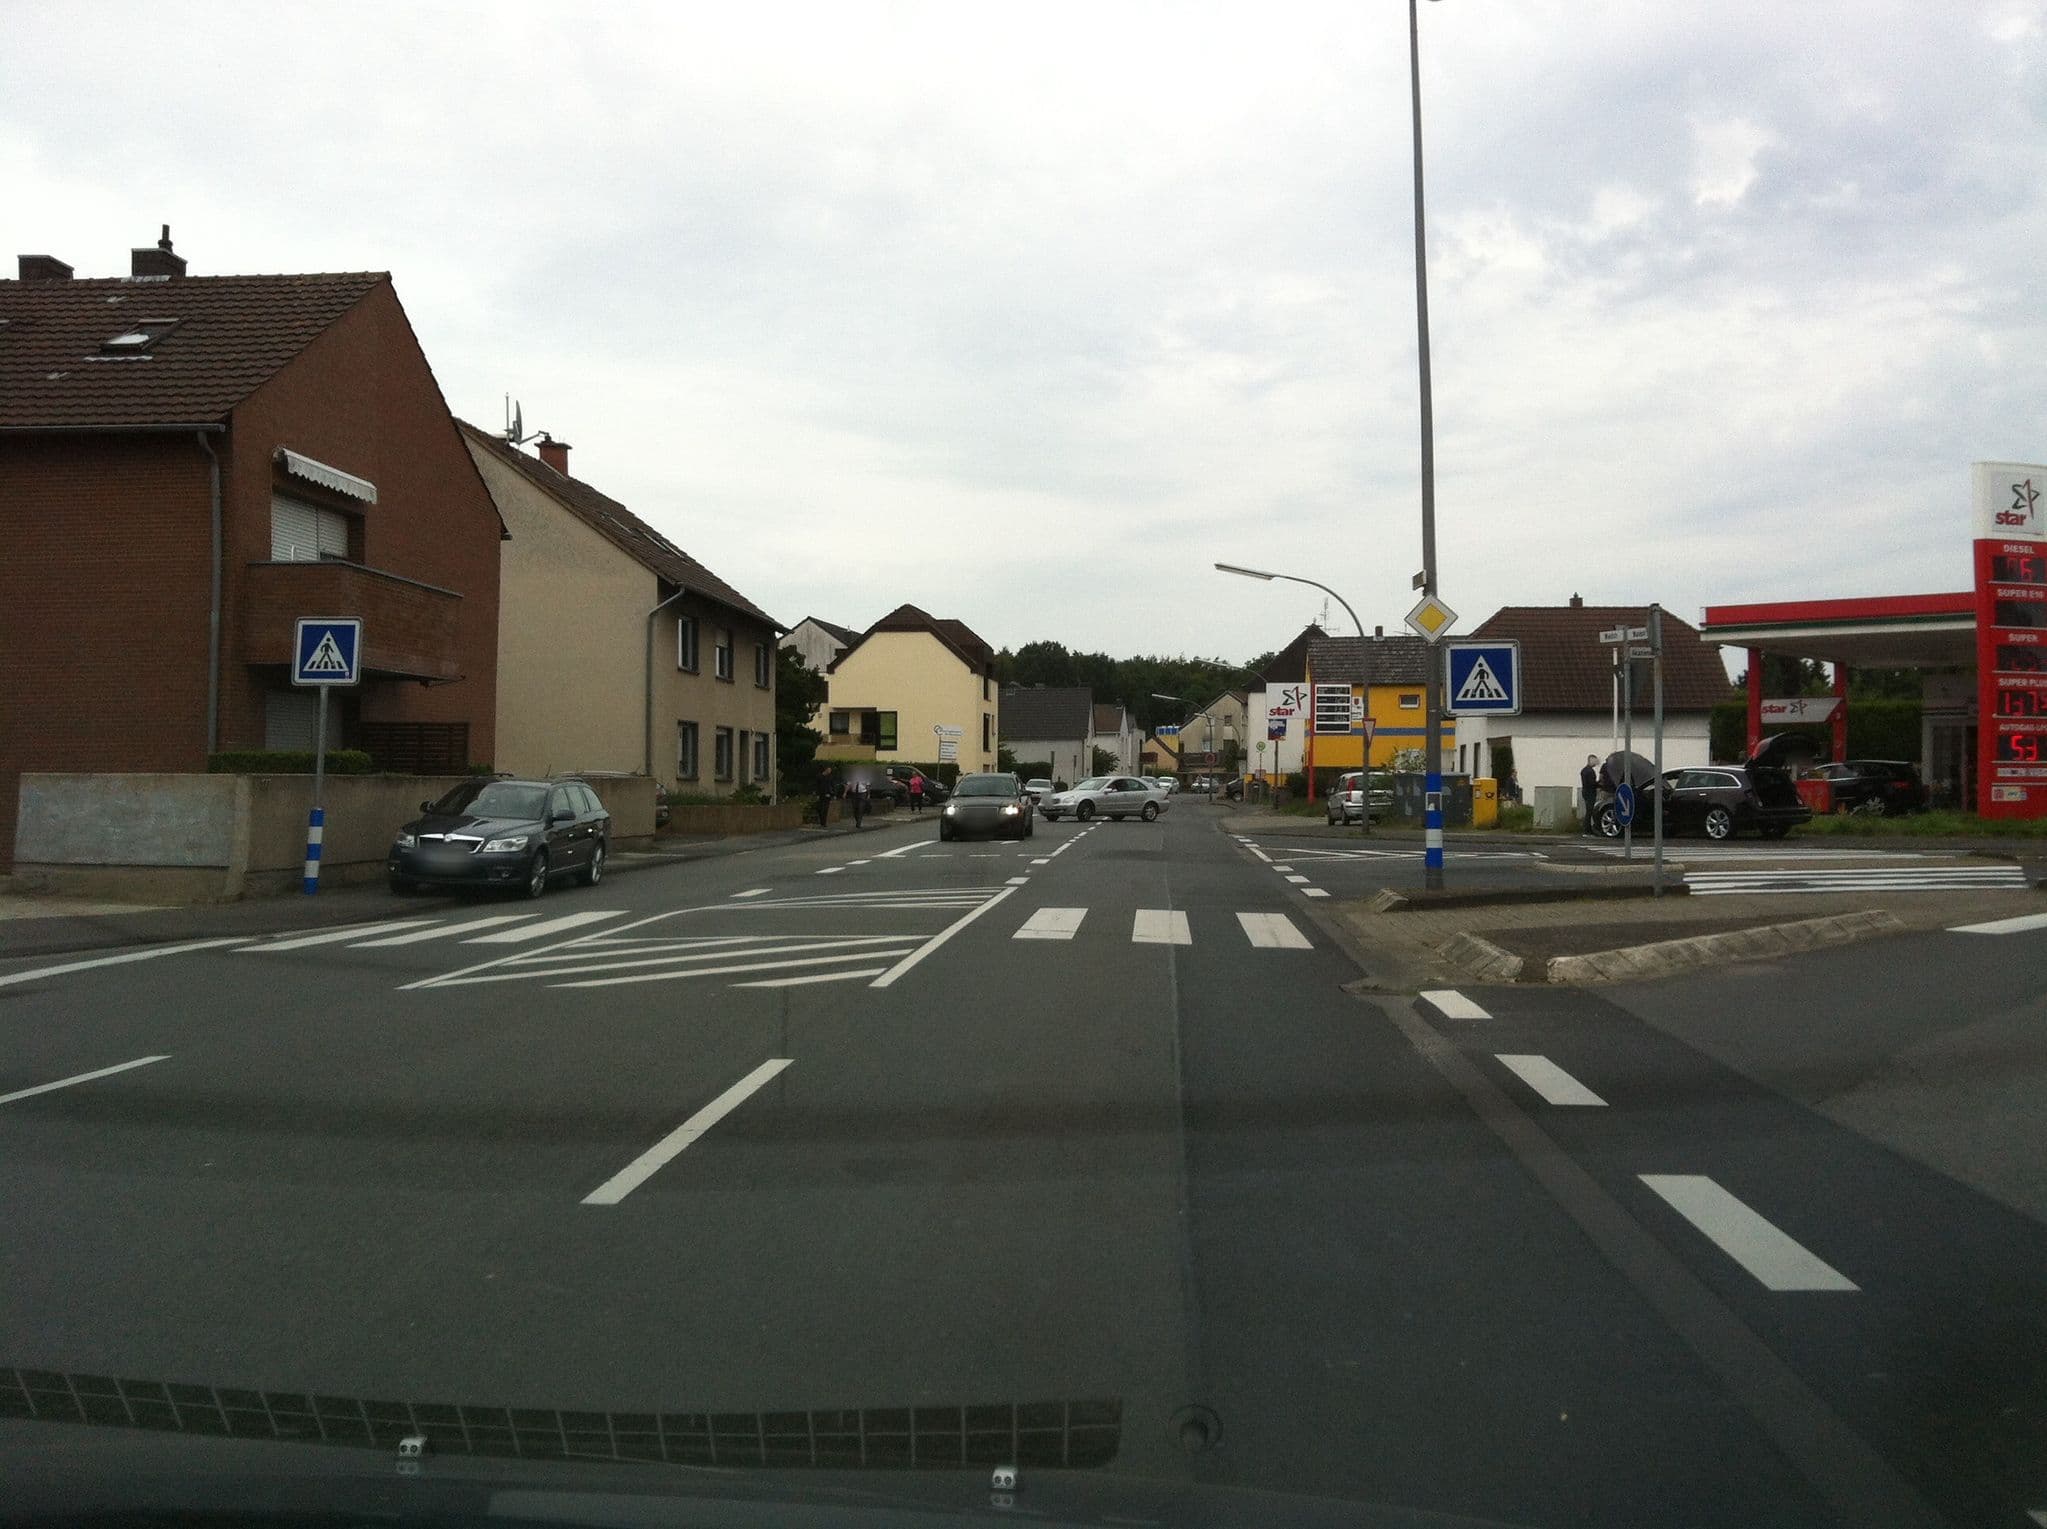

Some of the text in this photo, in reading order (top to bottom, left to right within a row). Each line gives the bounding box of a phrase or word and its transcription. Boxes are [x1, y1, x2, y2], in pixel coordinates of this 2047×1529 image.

[1995, 510, 2027, 526] star
[2003, 545, 2034, 554] DIESEL
[1997, 589, 2027, 598] SUPER
[2008, 633, 2038, 642] SUPER
[1999, 677, 2028, 687] SUPER
[1269, 706, 1295, 717] star
[1761, 704, 1787, 714] star
